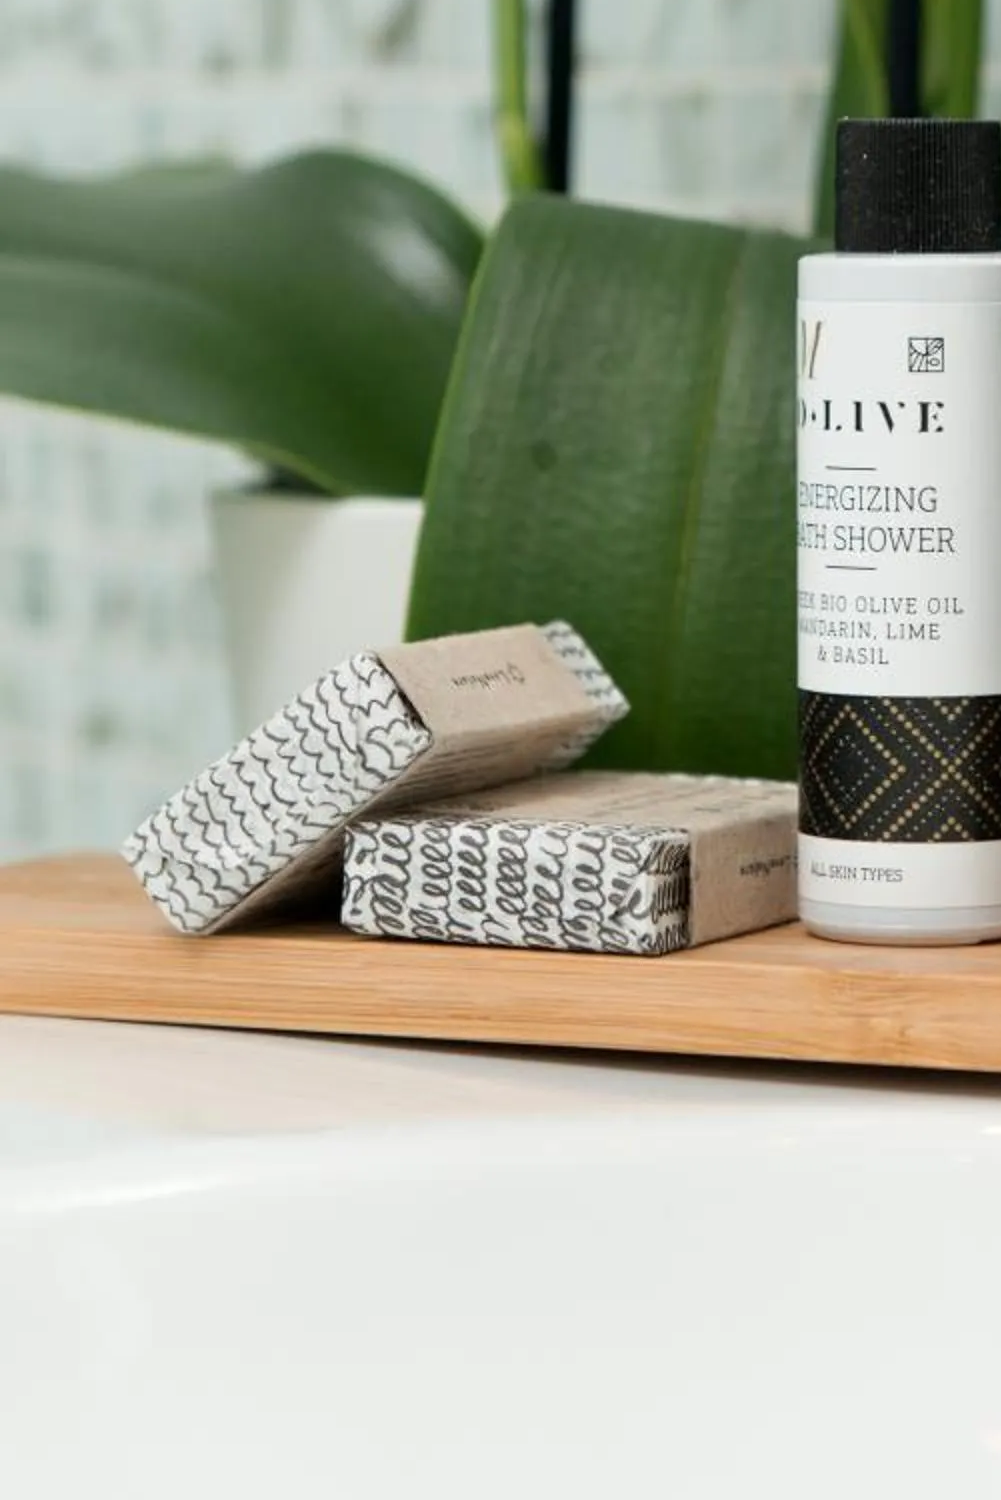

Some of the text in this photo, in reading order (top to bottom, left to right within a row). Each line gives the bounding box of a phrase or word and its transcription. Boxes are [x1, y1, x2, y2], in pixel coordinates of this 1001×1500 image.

[799, 482, 938, 513] ENERGIZING
[833, 526, 955, 553] SHOWER
[821, 592, 847, 613] BIO
[855, 596, 918, 615] OLIVE
[926, 597, 964, 614] OIL
[886, 621, 941, 640] LIME
[817, 645, 889, 665] & BASIL
[810, 859, 827, 878] ALL
[829, 863, 857, 880] SKIN
[861, 866, 904, 883] TYPES
